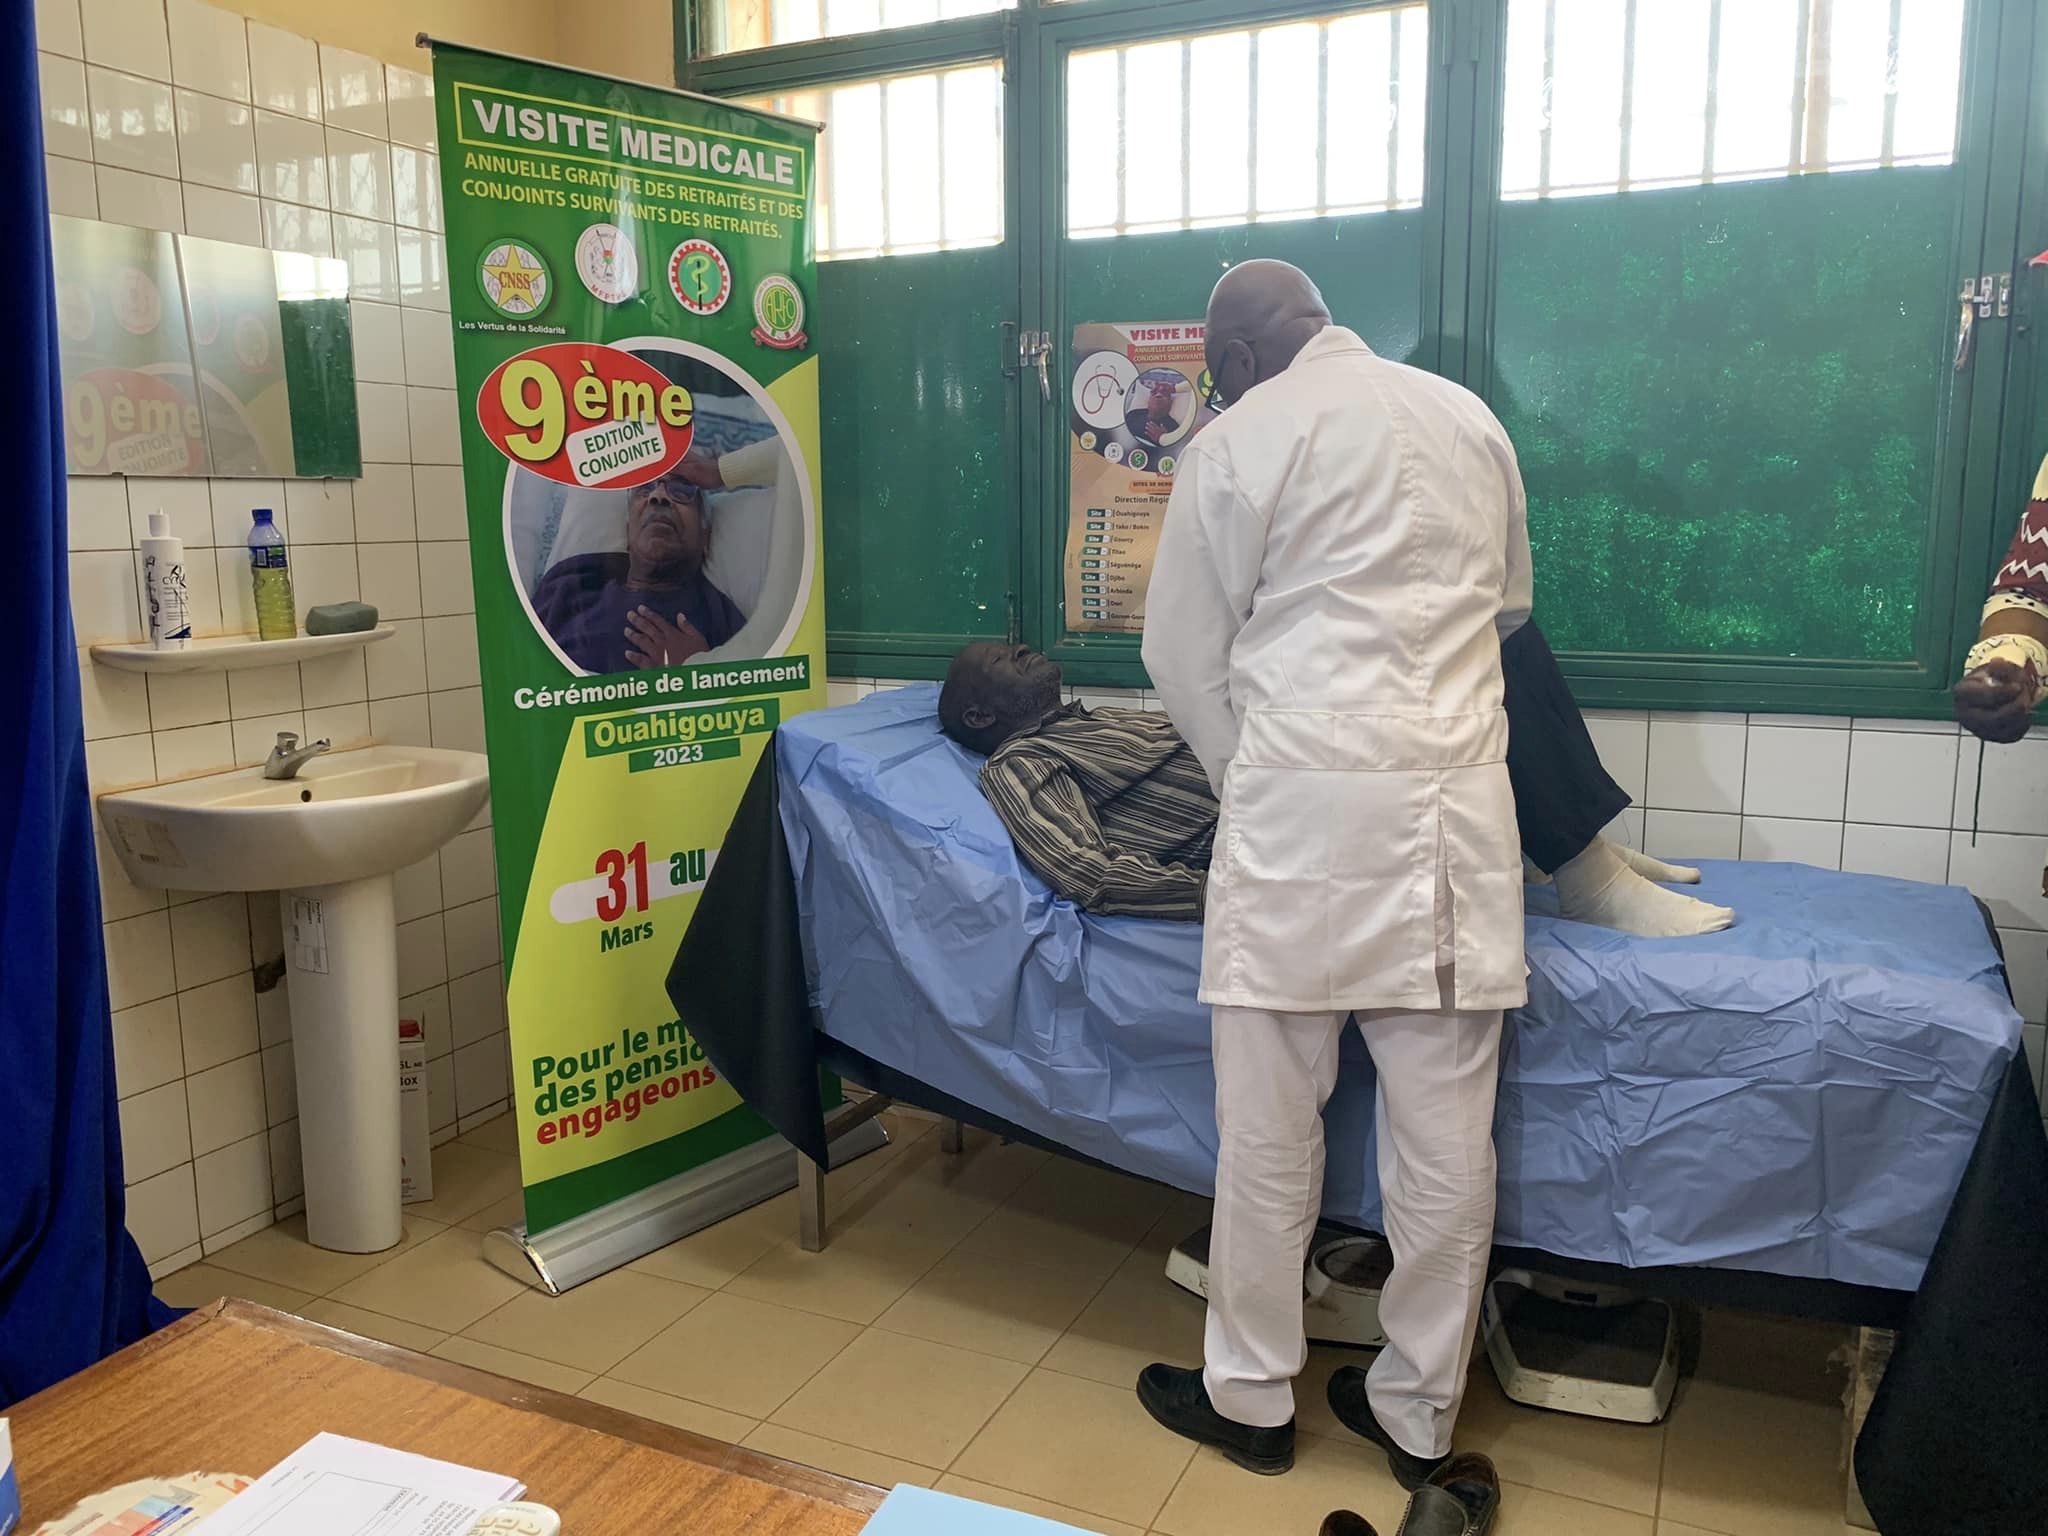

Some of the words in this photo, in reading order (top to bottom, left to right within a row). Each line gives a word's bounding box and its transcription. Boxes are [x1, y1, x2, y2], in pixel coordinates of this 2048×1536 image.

[472, 99, 609, 152] VISITE
[620, 126, 794, 184] MEDICALE
[465, 152, 561, 181] ANNUELLE
[565, 167, 641, 194] GRATUITE
[645, 181, 675, 199] DES
[679, 185, 756, 211] RETRAITÉS
[759, 199, 775, 214] ET
[778, 204, 803, 219] DES
[462, 179, 566, 207] CONJOINTS
[570, 193, 667, 222] SURVIVANTS
[671, 209, 700, 227] DES
[703, 214, 782, 239] RETRAITÉS.
[499, 270, 531, 290] CNSS
[458, 321, 475, 329] Les
[477, 321, 505, 331] Vertus
[507, 323, 516, 331] de
[518, 324, 526, 332] la
[1130, 328, 1180, 341] VISITE
[500, 359, 694, 462] 9ème
[578, 437, 661, 478] CONJOINTE
[584, 421, 644, 454] EDITION
[1114, 495, 1148, 503] Direction
[514, 677, 648, 710] Cérémonie
[655, 673, 683, 693] de
[692, 662, 805, 689] lancement
[594, 707, 765, 748] Ouahigouya
[653, 744, 704, 768] 2023
[595, 841, 649, 923] 31
[670, 848, 706, 886] au
[601, 921, 654, 953] Mars
[532, 1042, 615, 1088] Pour
[622, 1029, 649, 1058] le
[657, 1019, 692, 1046] m
[534, 1077, 597, 1116] des
[537, 1065, 717, 1145] engageons
